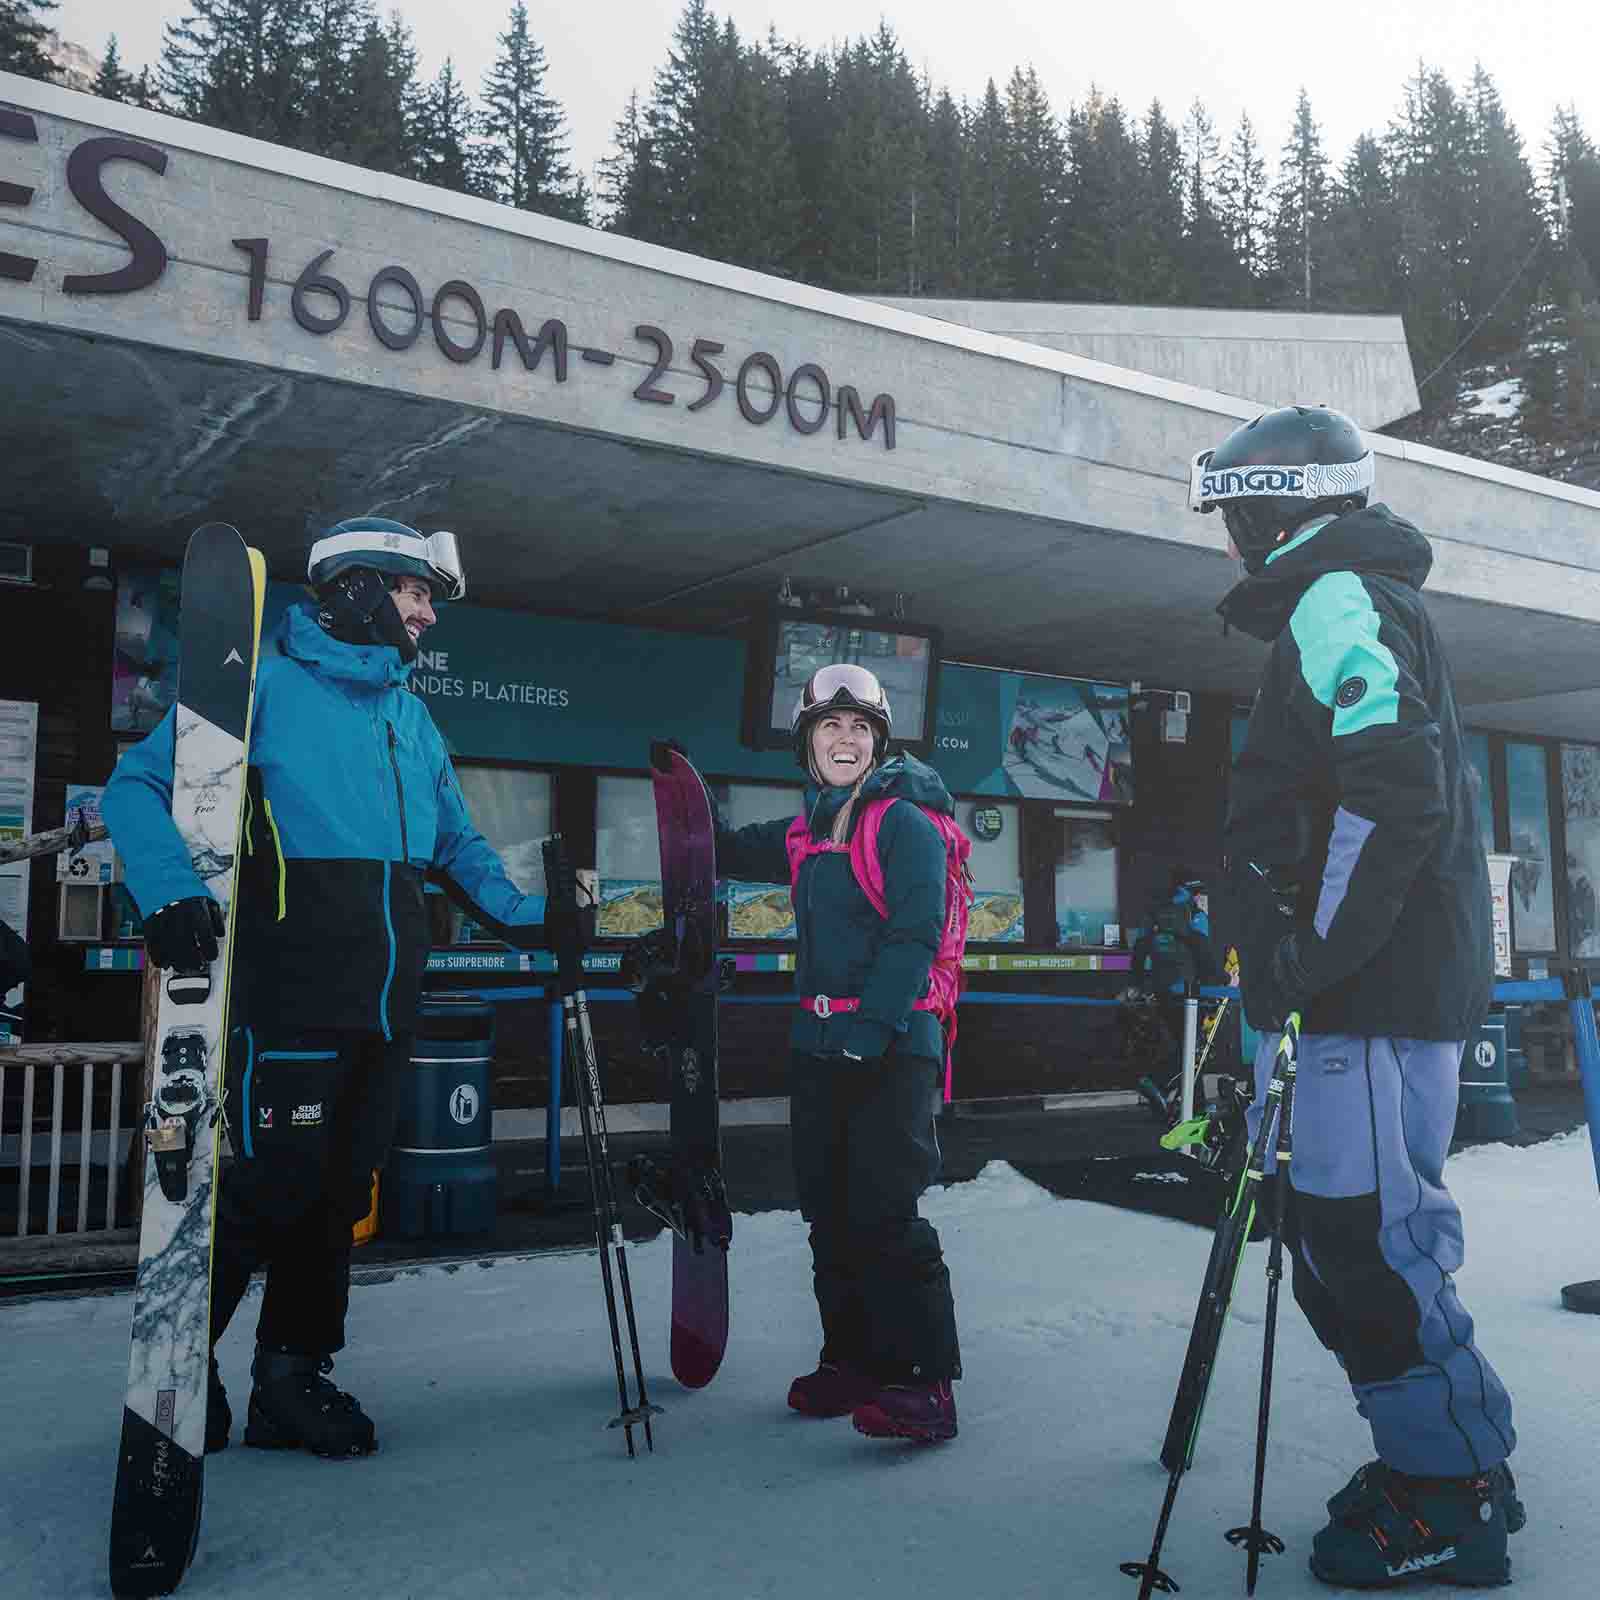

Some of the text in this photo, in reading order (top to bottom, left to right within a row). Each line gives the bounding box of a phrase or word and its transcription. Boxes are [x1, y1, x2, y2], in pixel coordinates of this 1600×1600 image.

[412, 650, 449, 672] NE
[400, 674, 465, 697] ANDES
[934, 735, 969, 750] .COM
[447, 956, 505, 968] SURPRENDRE
[291, 1109, 321, 1120] leade
[1385, 1546, 1457, 1577] LANGE
